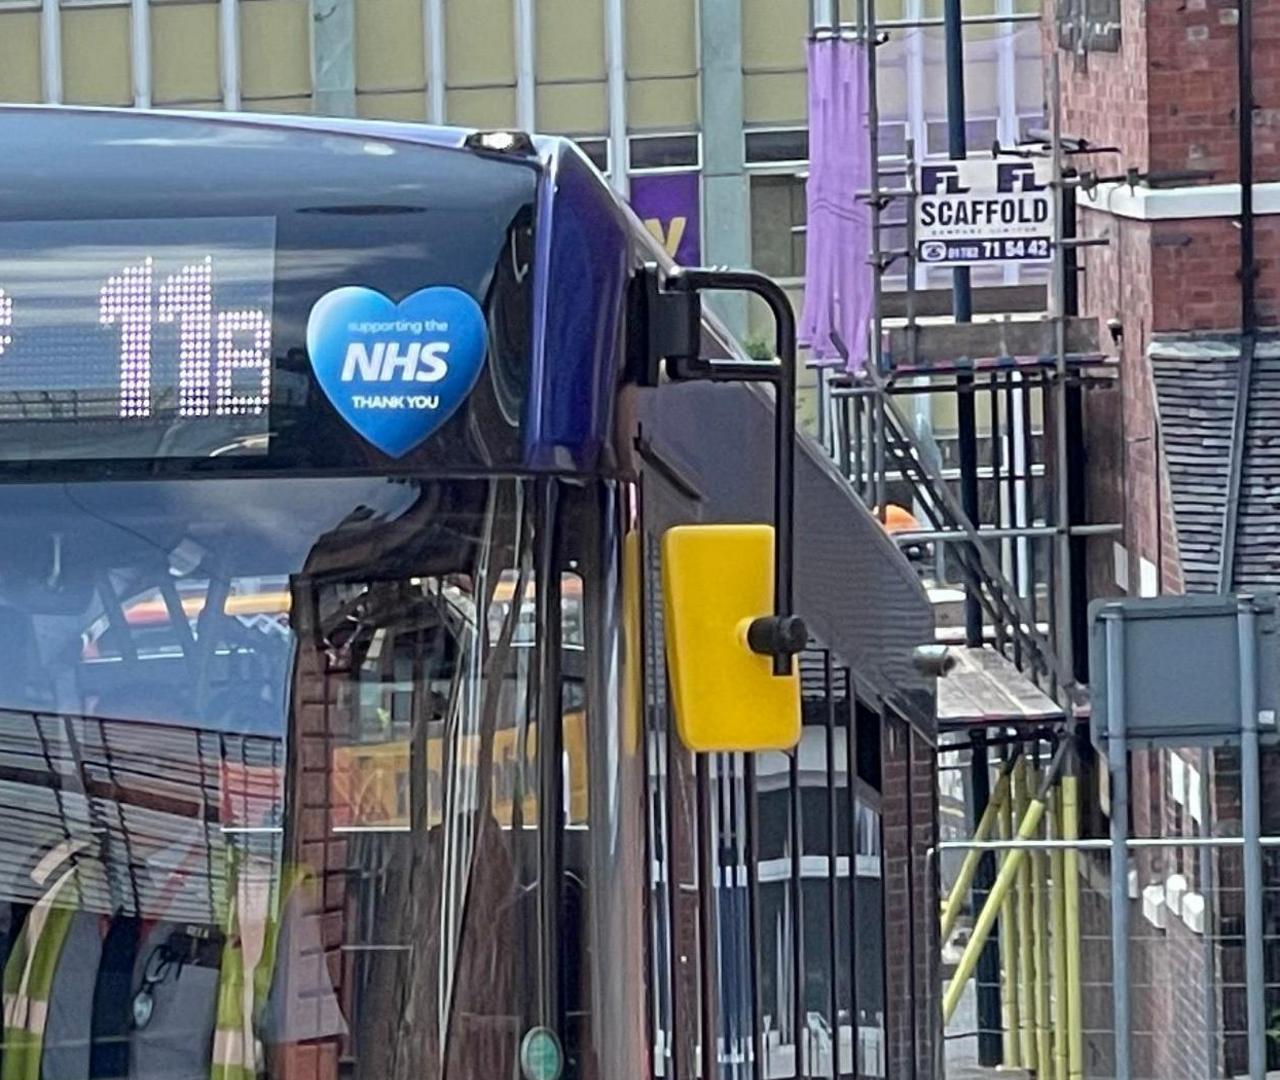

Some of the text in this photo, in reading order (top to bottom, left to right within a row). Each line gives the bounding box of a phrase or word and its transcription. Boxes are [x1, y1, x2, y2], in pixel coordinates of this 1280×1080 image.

[920, 198, 1048, 226] SCAFFOLD
[348, 319, 448, 334] supporting the
[342, 341, 450, 382] NHS
[352, 395, 440, 409] THANK YOU
